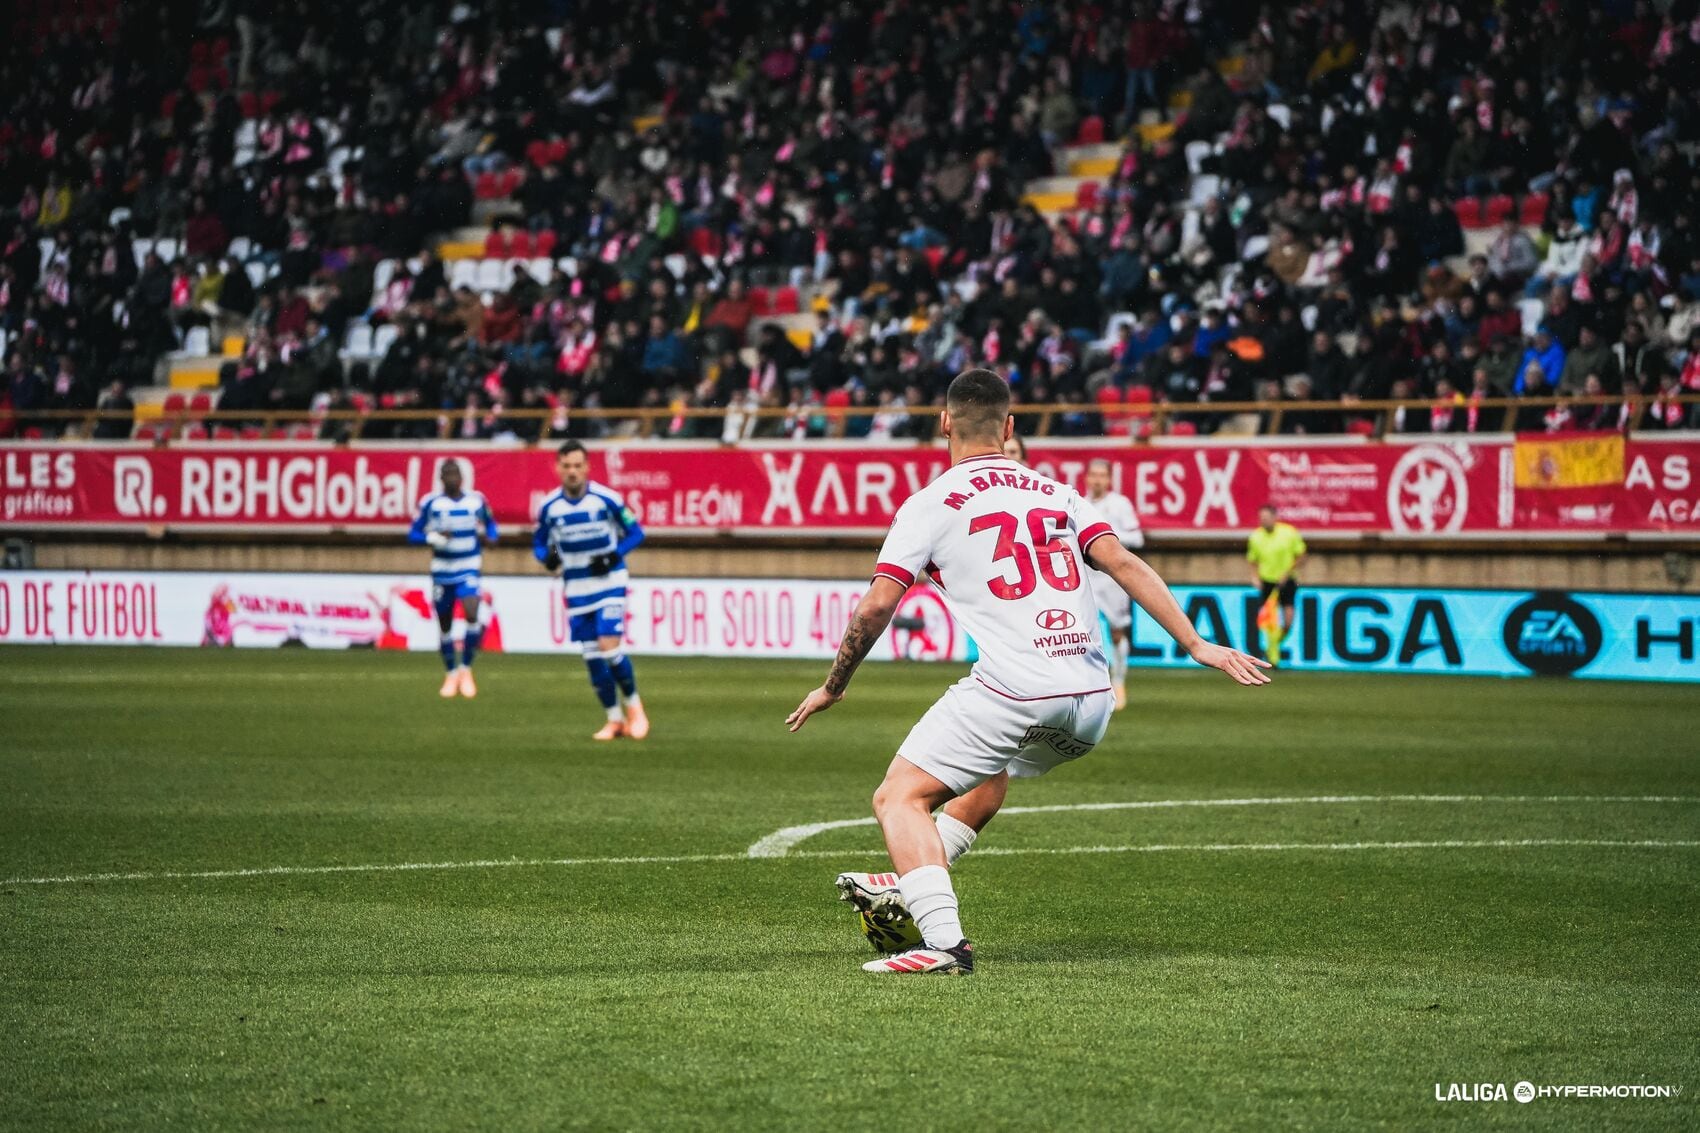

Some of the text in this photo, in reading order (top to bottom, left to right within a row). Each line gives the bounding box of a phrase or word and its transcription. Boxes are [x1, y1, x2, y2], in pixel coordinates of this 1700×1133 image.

[0, 453, 75, 488] LES
[181, 456, 420, 517] RBHGlobal
[1625, 455, 1691, 490] AS
[674, 483, 743, 525] LEÓN
[943, 492, 975, 511] M.
[969, 508, 1081, 600] 36
[24, 582, 54, 636] DE
[650, 589, 708, 646] POR
[722, 590, 793, 648] SOLO
[1521, 610, 1584, 640] EA
[1033, 632, 1091, 648] HYUNDAI
[1045, 646, 1086, 658] Lemauto
